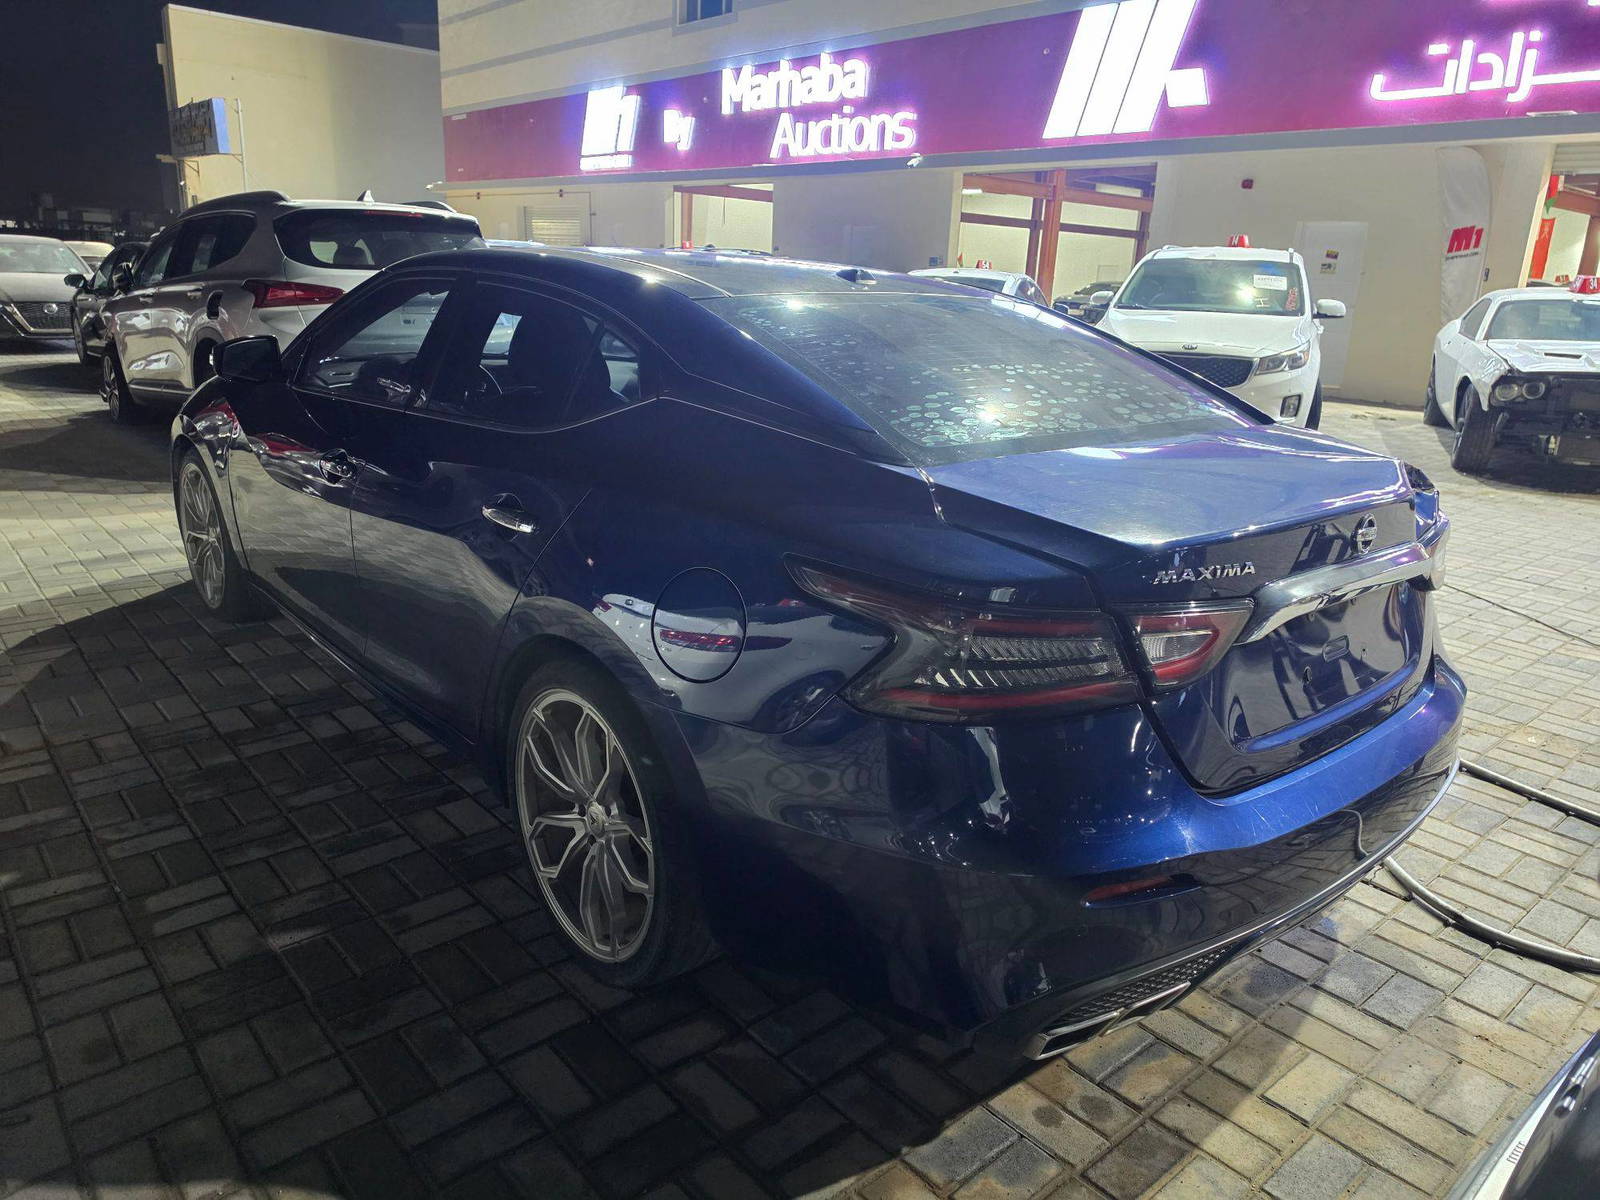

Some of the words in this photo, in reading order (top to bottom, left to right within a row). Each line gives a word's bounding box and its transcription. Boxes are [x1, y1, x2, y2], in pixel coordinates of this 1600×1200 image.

[721, 52, 868, 114] Marhaba
[663, 109, 695, 150] By
[769, 106, 915, 158] Auctions
[1153, 561, 1256, 584] MAXIMA
